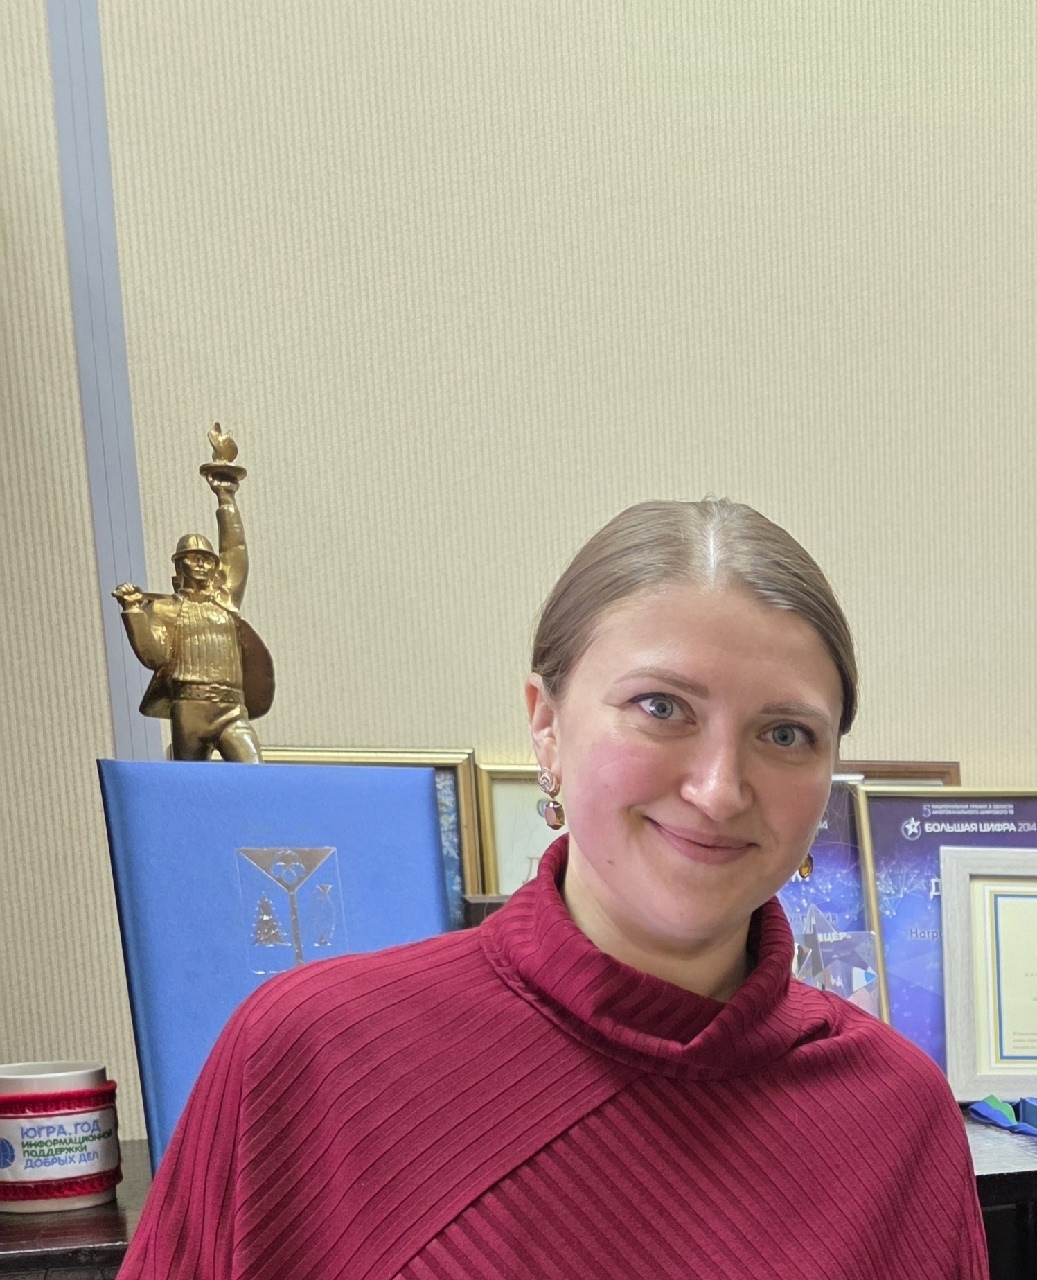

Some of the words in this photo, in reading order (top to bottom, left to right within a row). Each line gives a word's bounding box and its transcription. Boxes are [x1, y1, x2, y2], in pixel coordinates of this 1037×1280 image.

[924, 822, 978, 833] БОЛЬШАЯ
[979, 822, 1017, 834] ЦИФРА
[1018, 822, 1037, 832] 2014
[74, 1119, 100, 1134] ГОД
[21, 1128, 112, 1149] ИНФОРМАЦИОННОЙ
[22, 1144, 88, 1158] ПОДДЕРЖКИ
[25, 1154, 76, 1169] ДОБРЫХ
[78, 1151, 99, 1164] ДЕЛ
